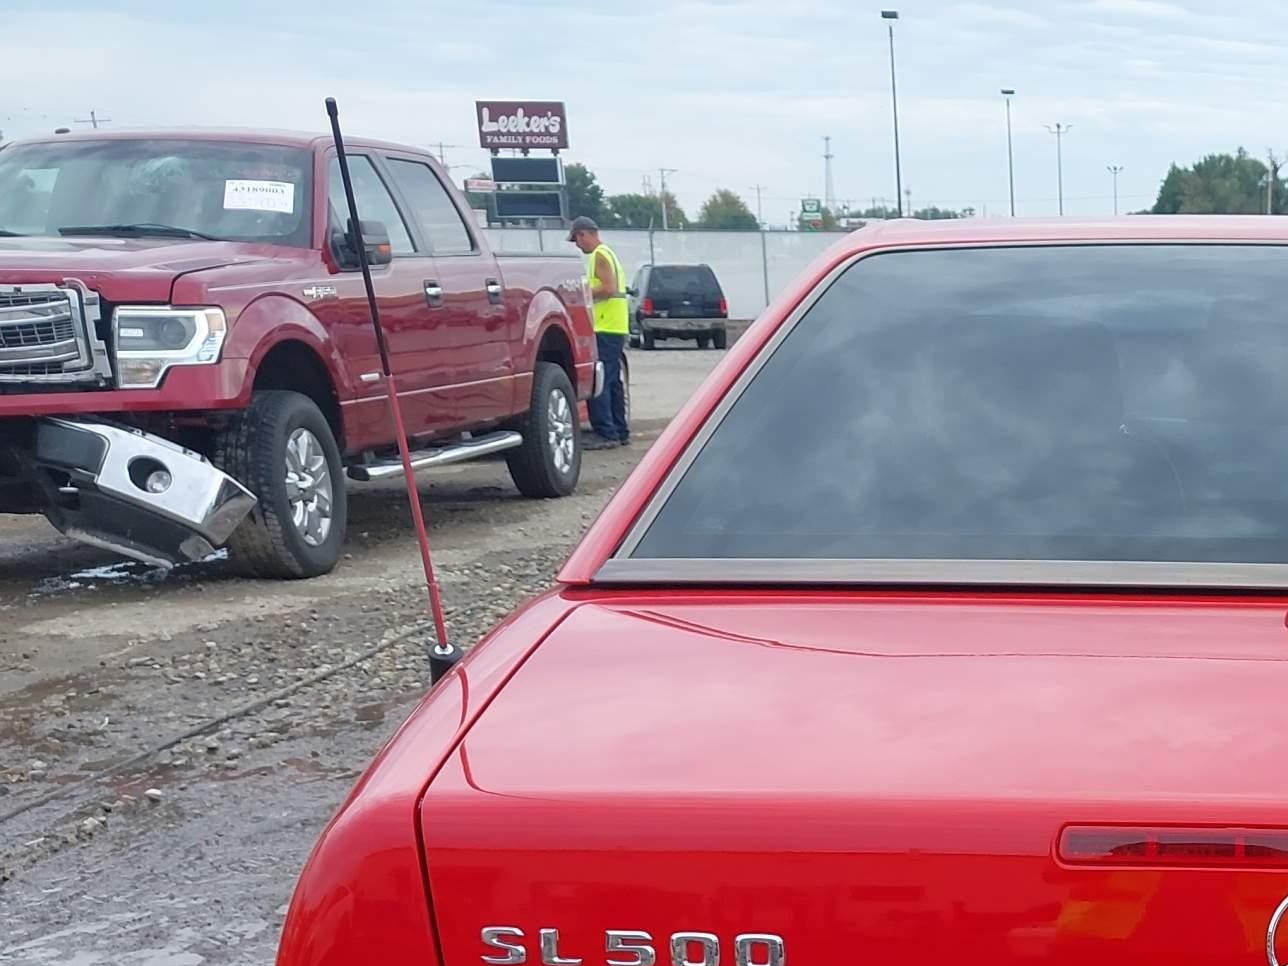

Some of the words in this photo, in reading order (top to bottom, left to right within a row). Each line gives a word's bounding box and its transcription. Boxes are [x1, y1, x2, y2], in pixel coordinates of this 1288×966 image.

[481, 107, 561, 133] Leeker's
[486, 135, 523, 144] FAMILY
[525, 135, 559, 144] FOODS
[480, 926, 583, 966] SL
